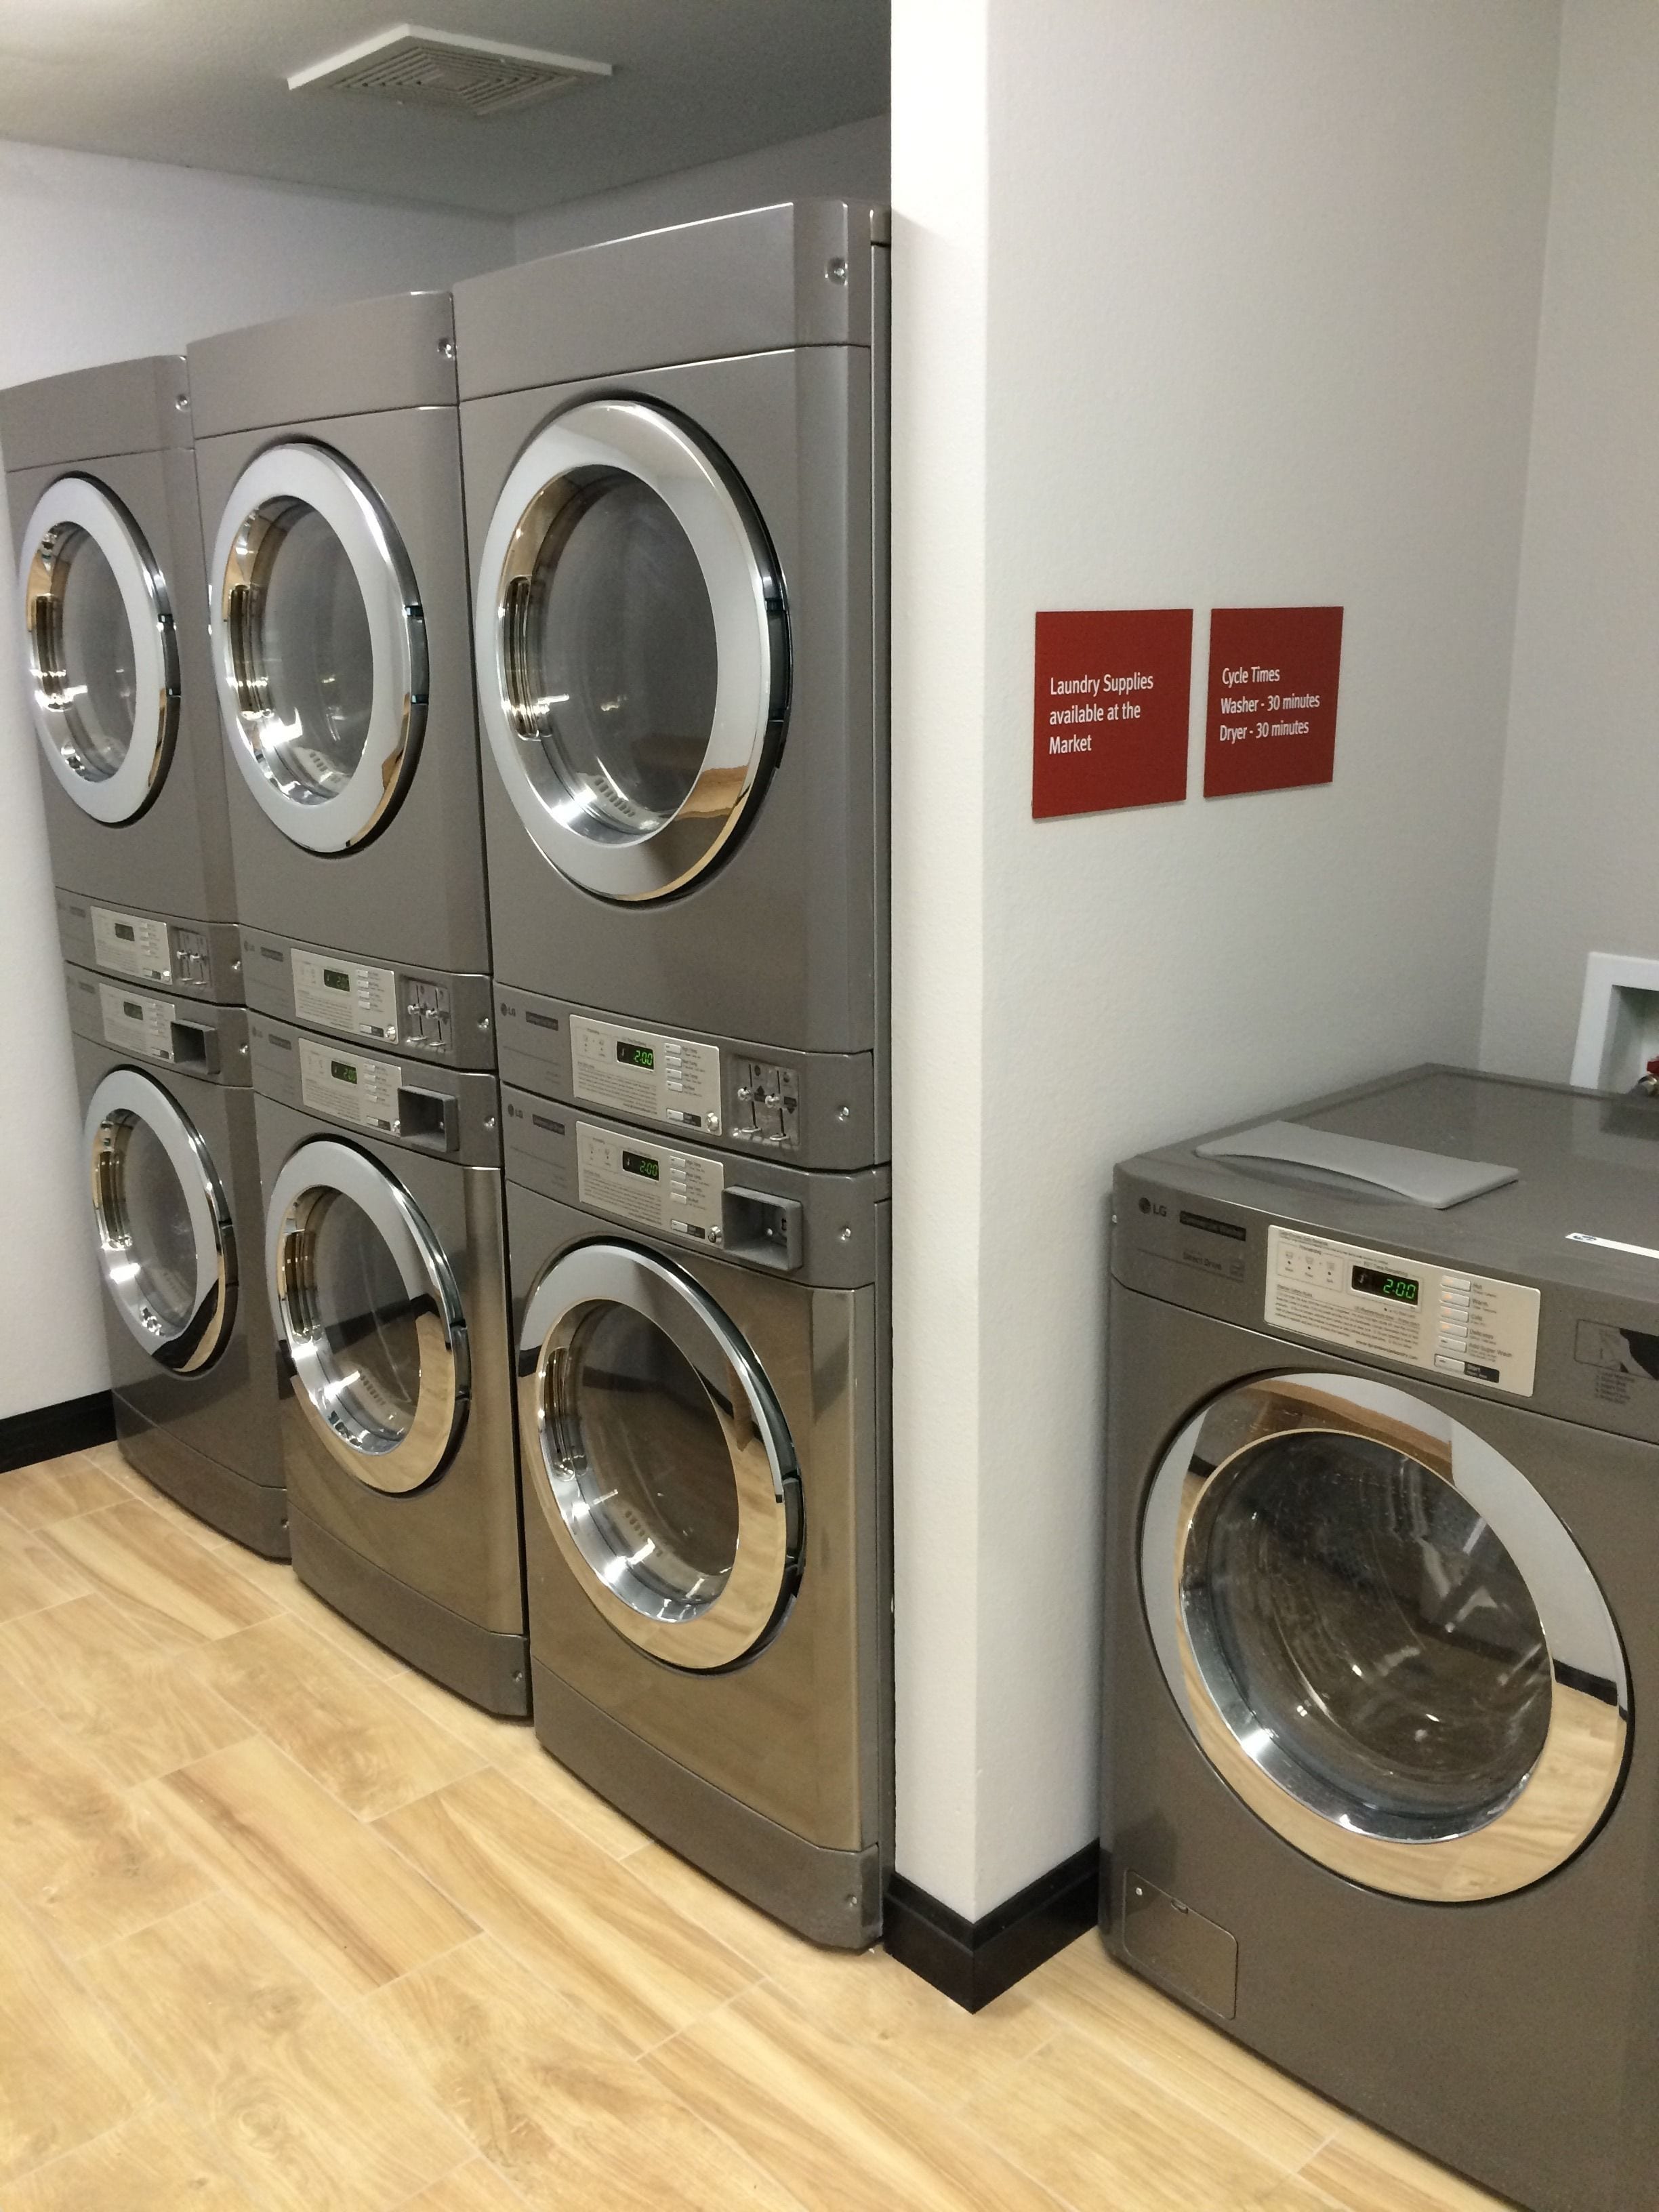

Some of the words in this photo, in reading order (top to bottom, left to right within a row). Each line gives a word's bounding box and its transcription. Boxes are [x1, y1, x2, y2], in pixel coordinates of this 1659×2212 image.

[1050, 674, 1101, 697] Laundry
[1103, 672, 1153, 695] Supplies
[1222, 666, 1248, 689] Cycle
[1251, 665, 1280, 683] Times
[1049, 703, 1104, 725] available
[1107, 703, 1120, 720] at
[1122, 701, 1141, 719] the
[1221, 695, 1259, 714] Washer
[1267, 695, 1280, 712] 30
[1282, 693, 1320, 710] minutes
[1049, 734, 1092, 754] Market
[1219, 724, 1248, 744] Dryer
[1255, 722, 1269, 739] 30
[1271, 720, 1309, 736] minutes
[1153, 1204, 1167, 1217] LG
